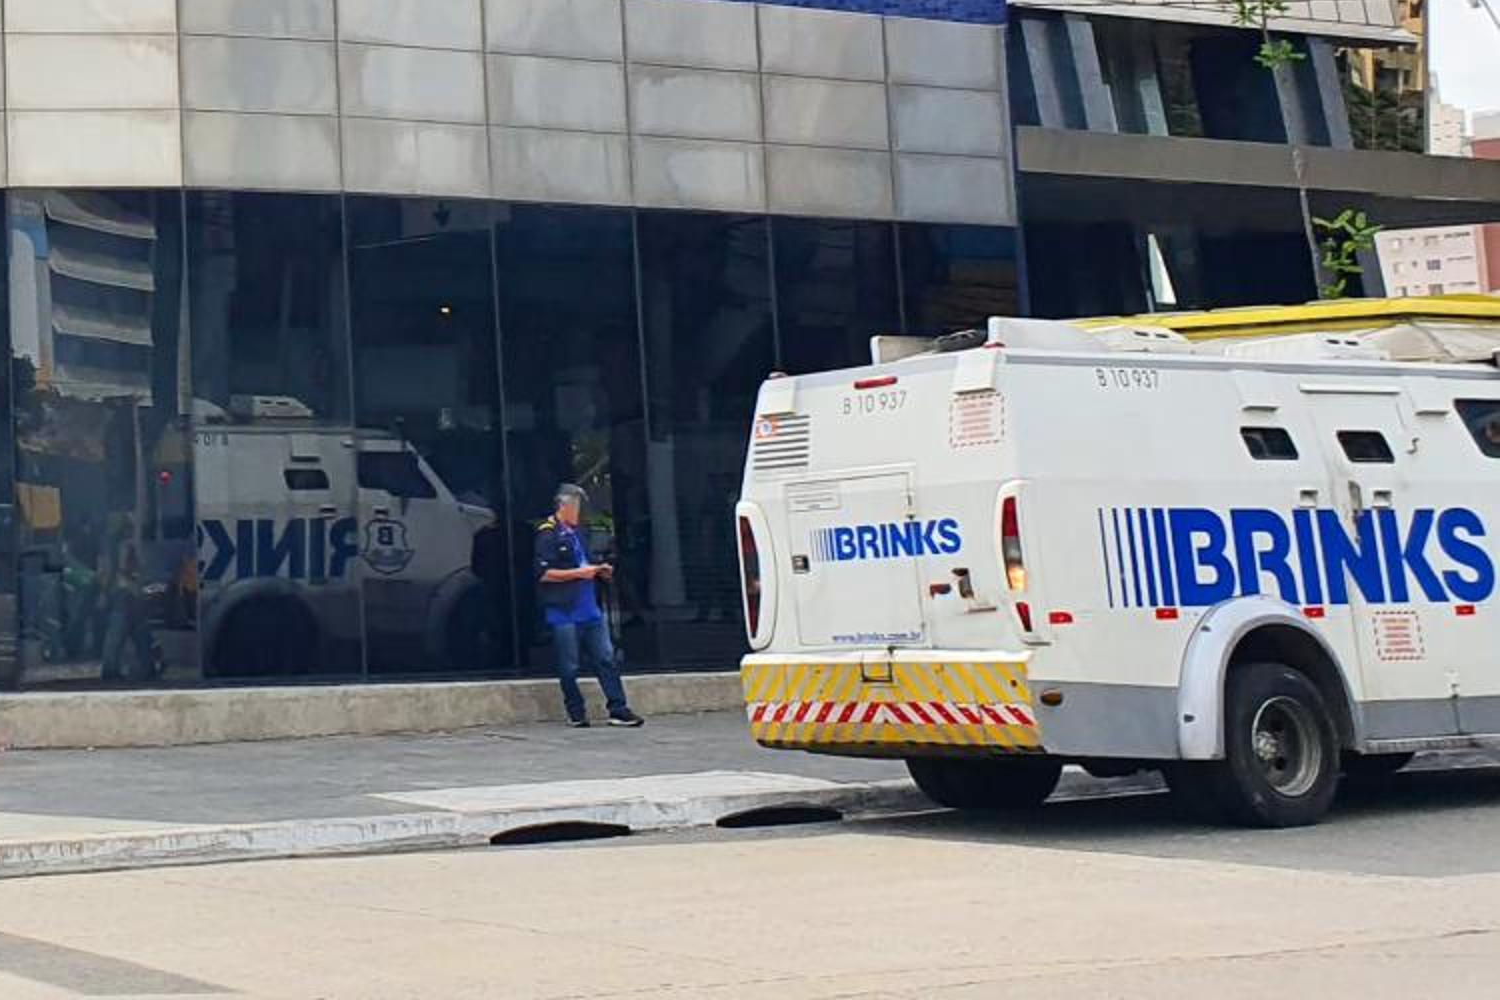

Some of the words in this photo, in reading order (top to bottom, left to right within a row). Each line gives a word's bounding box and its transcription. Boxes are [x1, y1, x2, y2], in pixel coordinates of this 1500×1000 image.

[843, 396, 851, 415] B
[857, 394, 875, 414] 10
[879, 390, 907, 411] 937
[833, 518, 962, 561] BRINKS
[1168, 507, 1496, 607] BRINKS
